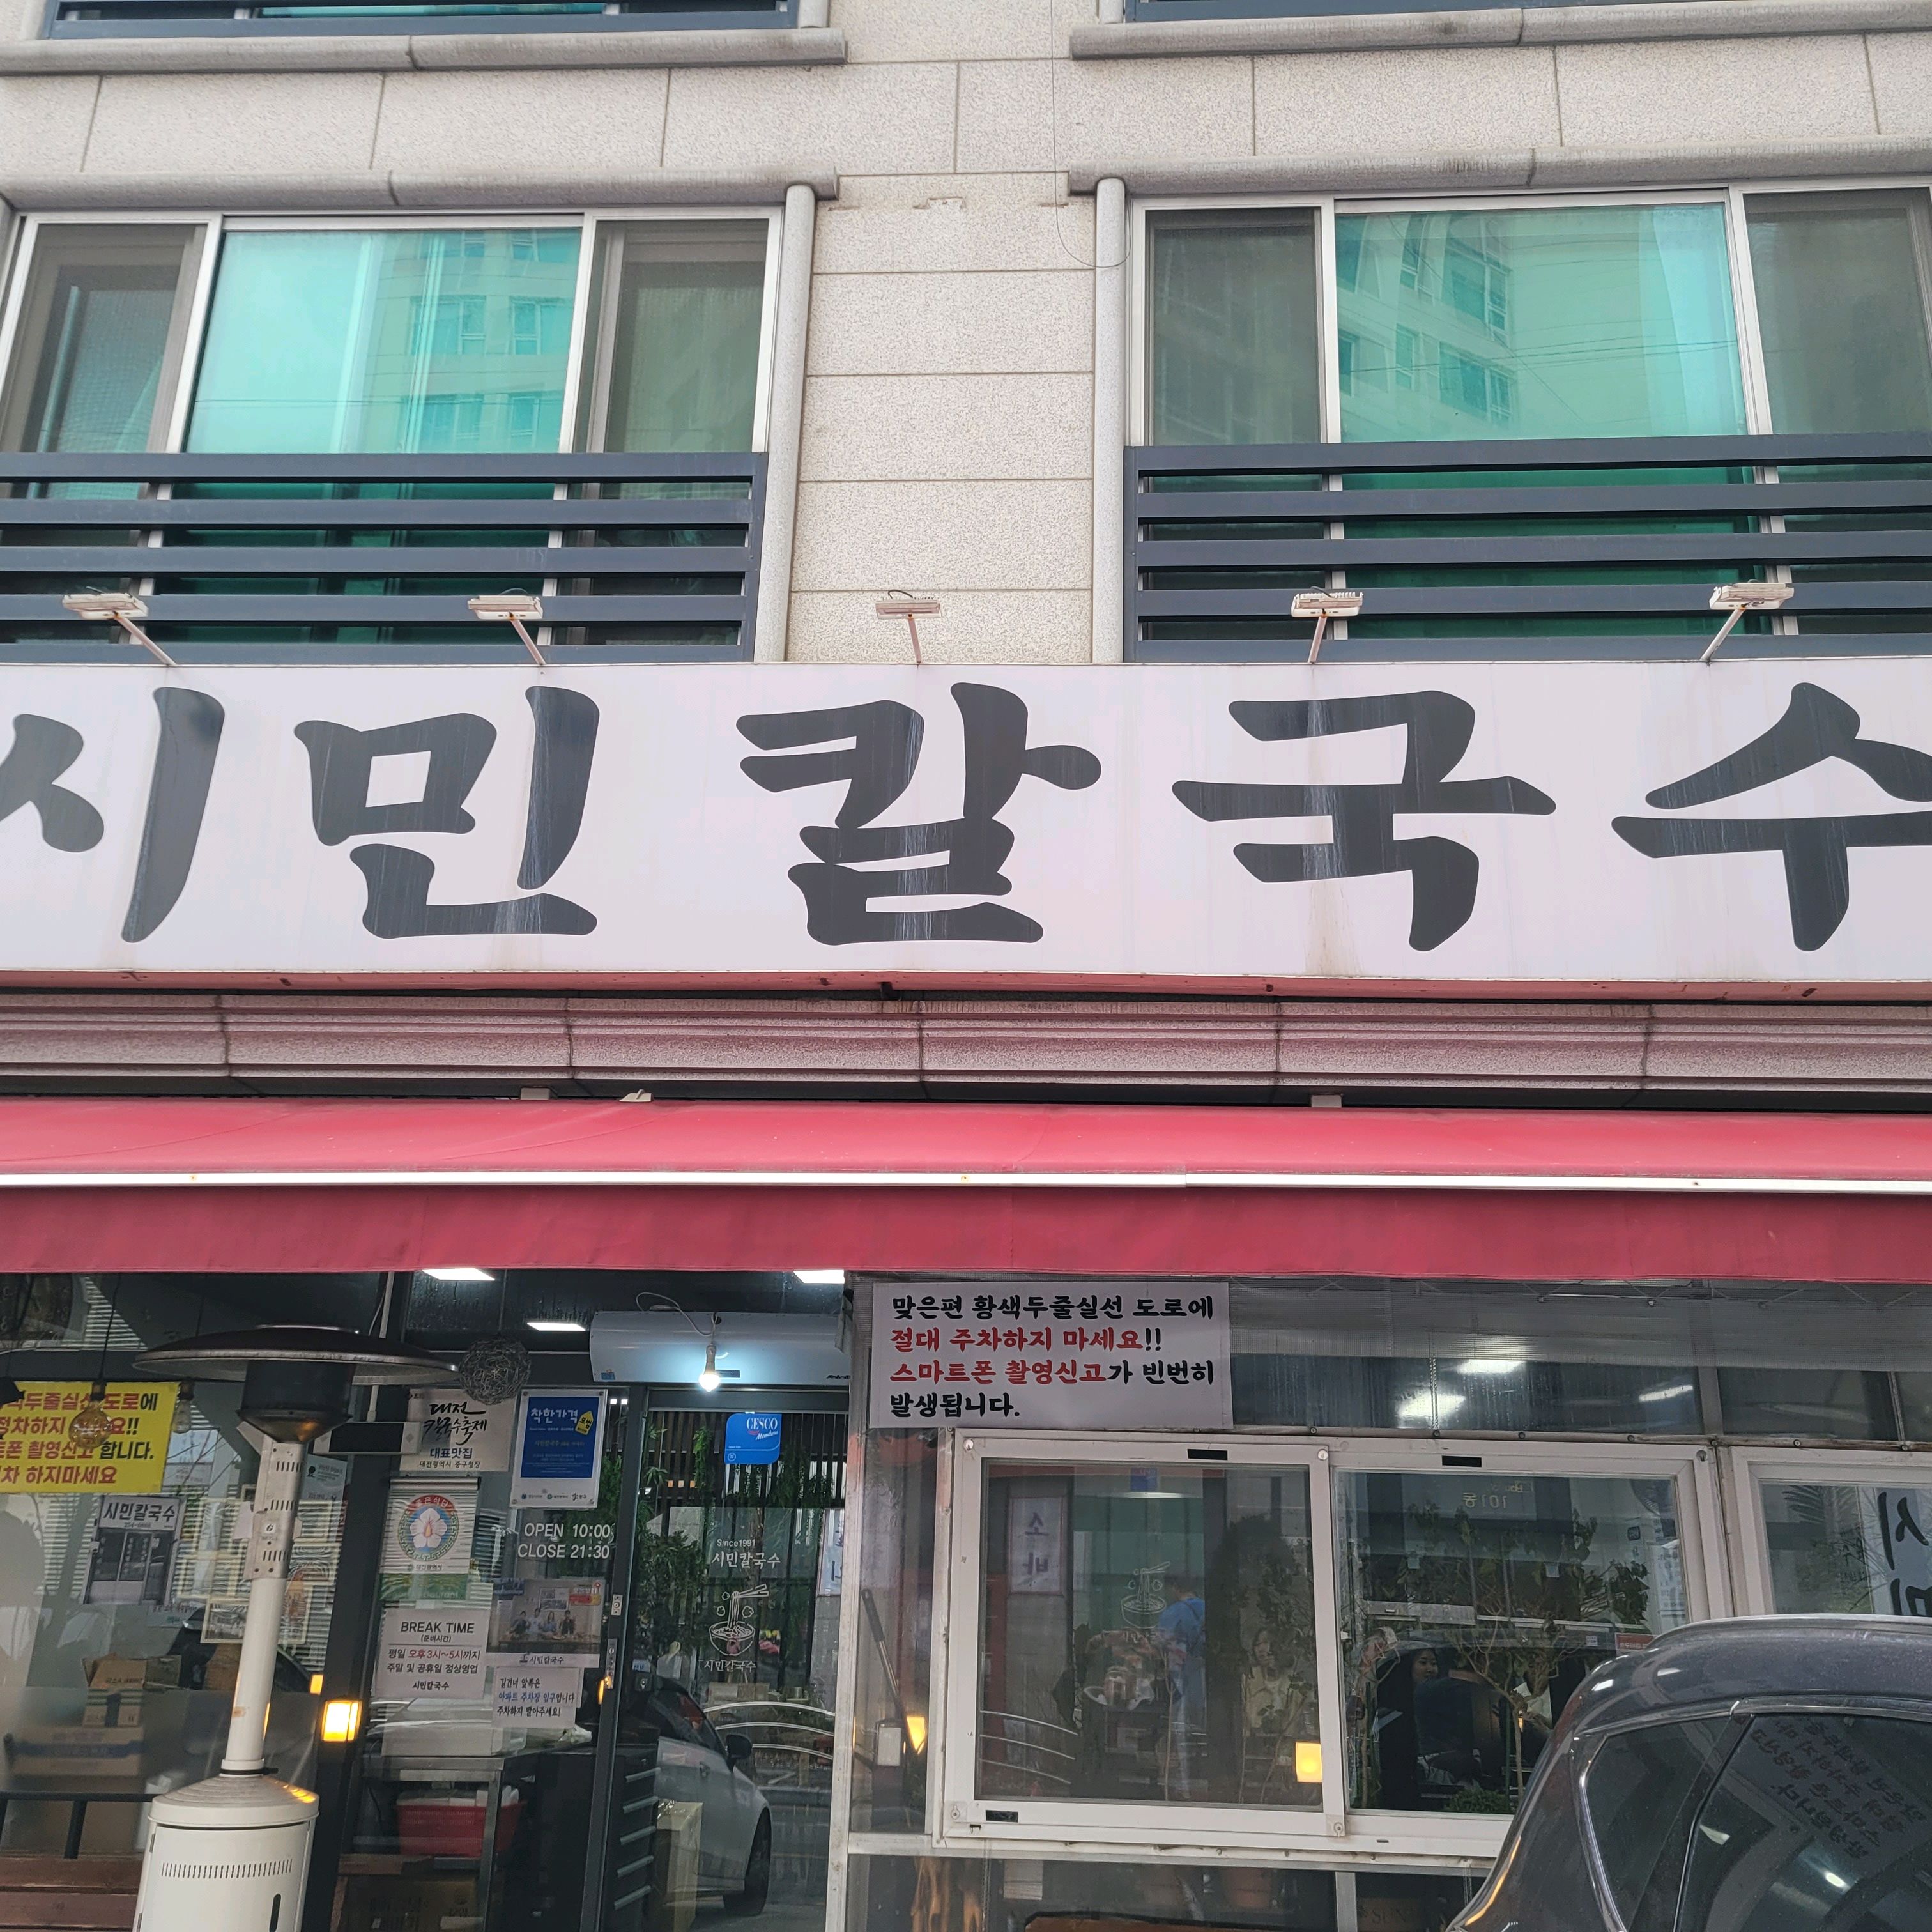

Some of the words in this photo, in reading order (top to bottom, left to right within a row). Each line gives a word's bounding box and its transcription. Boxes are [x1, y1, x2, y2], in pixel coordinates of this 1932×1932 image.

[0, 682, 1932, 951] 시민칼국수
[893, 1295, 962, 1319] 맞은편
[973, 1294, 1123, 1319] 황색두줄실선
[1132, 1296, 1213, 1319] 도로에
[890, 1327, 939, 1353] 절대
[949, 1327, 1051, 1353] 주차하지
[1063, 1327, 1162, 1353] 마세요!!
[889, 1360, 997, 1385] 스마트폰
[1004, 1360, 1133, 1385] 촬영신고가
[1142, 1360, 1214, 1385] 빈번히
[429, 1402, 487, 1415] 대전
[890, 1392, 1020, 1418] 발생됩니다.
[530, 1407, 578, 1424] 착한가격
[746, 1418, 778, 1430] CESCO
[100, 1441, 154, 1459] 합니다.
[430, 1448, 473, 1459] 대표맛집
[103, 1503, 175, 1522] 시민칼국수
[524, 1522, 564, 1537] OPEN
[572, 1523, 611, 1538] 10:00
[518, 1544, 566, 1558] CLOSE
[570, 1544, 610, 1559] 21:30
[711, 1551, 781, 1569] 시민칼국수
[400, 1621, 442, 1632] BREAK
[446, 1623, 475, 1634] TIME
[388, 1649, 406, 1659] 평일
[387, 1663, 404, 1673] 주말
[406, 1663, 415, 1673] 및
[417, 1663, 442, 1673] 공휴일
[445, 1664, 478, 1674] 정상영업
[704, 1661, 756, 1673] 시민칼국수
[413, 1681, 450, 1690] 시민칼국수
[499, 1692, 518, 1702] 아파트
[521, 1692, 541, 1703] 주차장
[543, 1692, 575, 1704] 입구입니다
[497, 1706, 523, 1717] 주차하지
